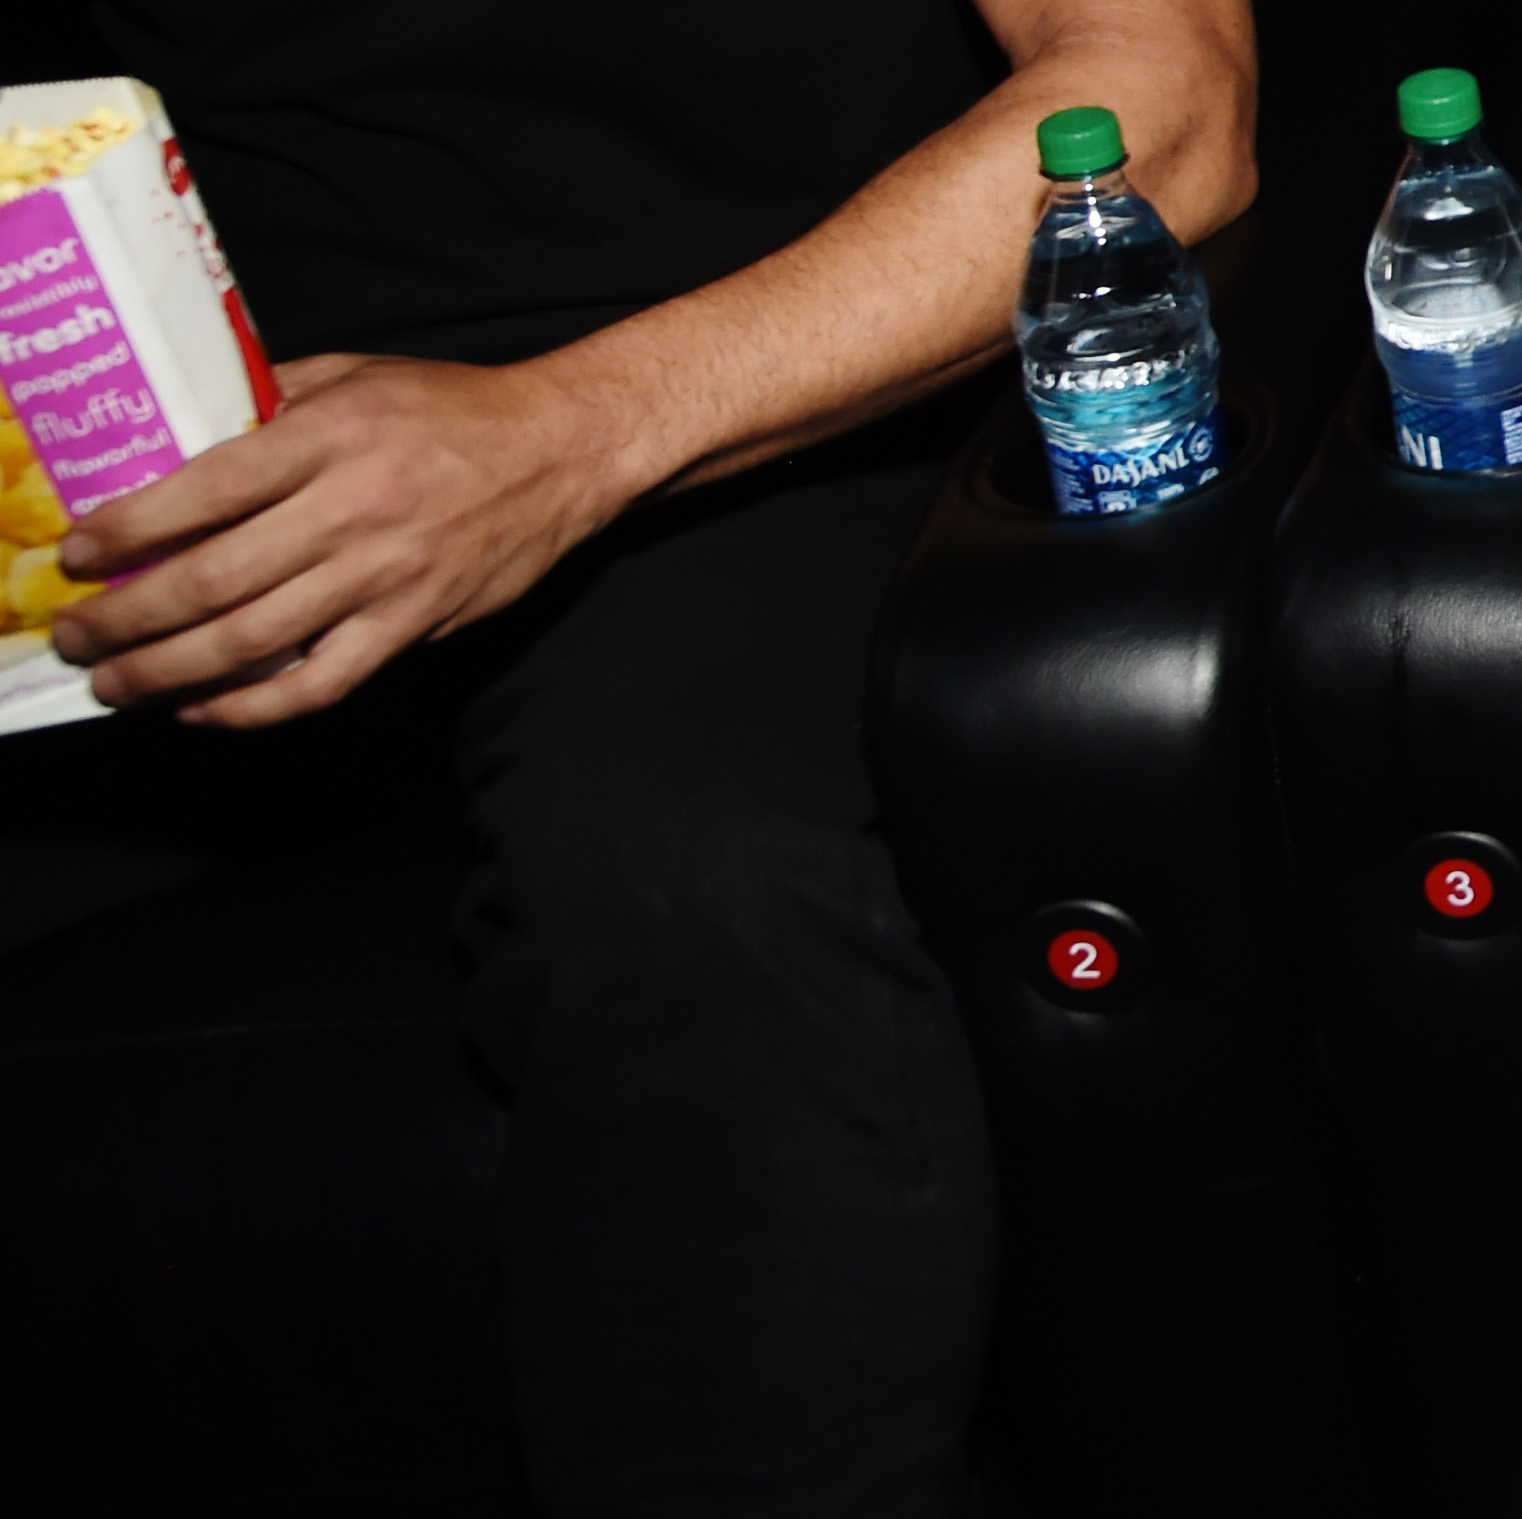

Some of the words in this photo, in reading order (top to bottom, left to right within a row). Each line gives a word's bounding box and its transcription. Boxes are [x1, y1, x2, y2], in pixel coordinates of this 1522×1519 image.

[0, 304, 116, 365] fresh
[31, 388, 156, 446] fluffy
[1092, 447, 1190, 488] DASANI
[1445, 871, 1474, 907] 3
[1069, 942, 1101, 979] 2
